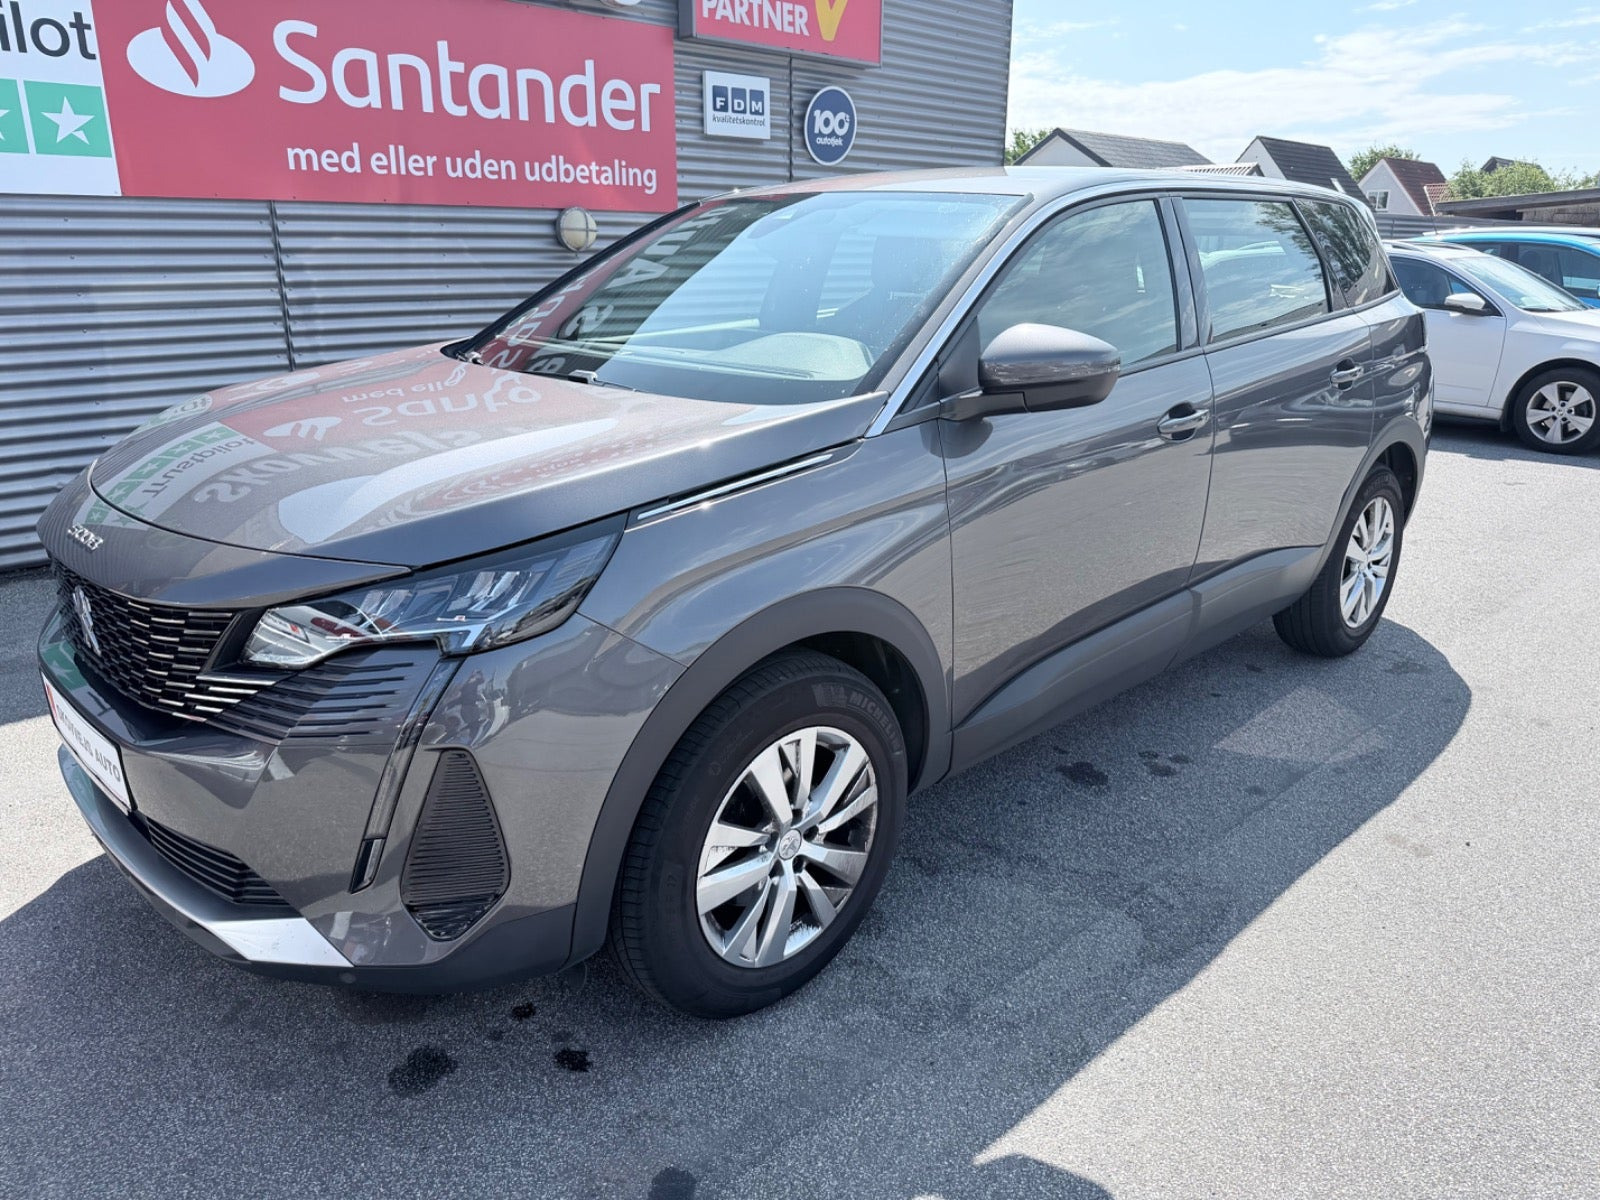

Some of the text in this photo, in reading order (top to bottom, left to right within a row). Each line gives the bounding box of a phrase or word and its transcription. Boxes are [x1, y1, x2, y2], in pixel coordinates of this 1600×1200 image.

[702, 0, 810, 37] PARTNER
[272, 20, 661, 133] Santander
[712, 114, 766, 127] kvalitetskontrol
[715, 97, 763, 114] FDM
[287, 142, 658, 195] med eller uden udbetaling
